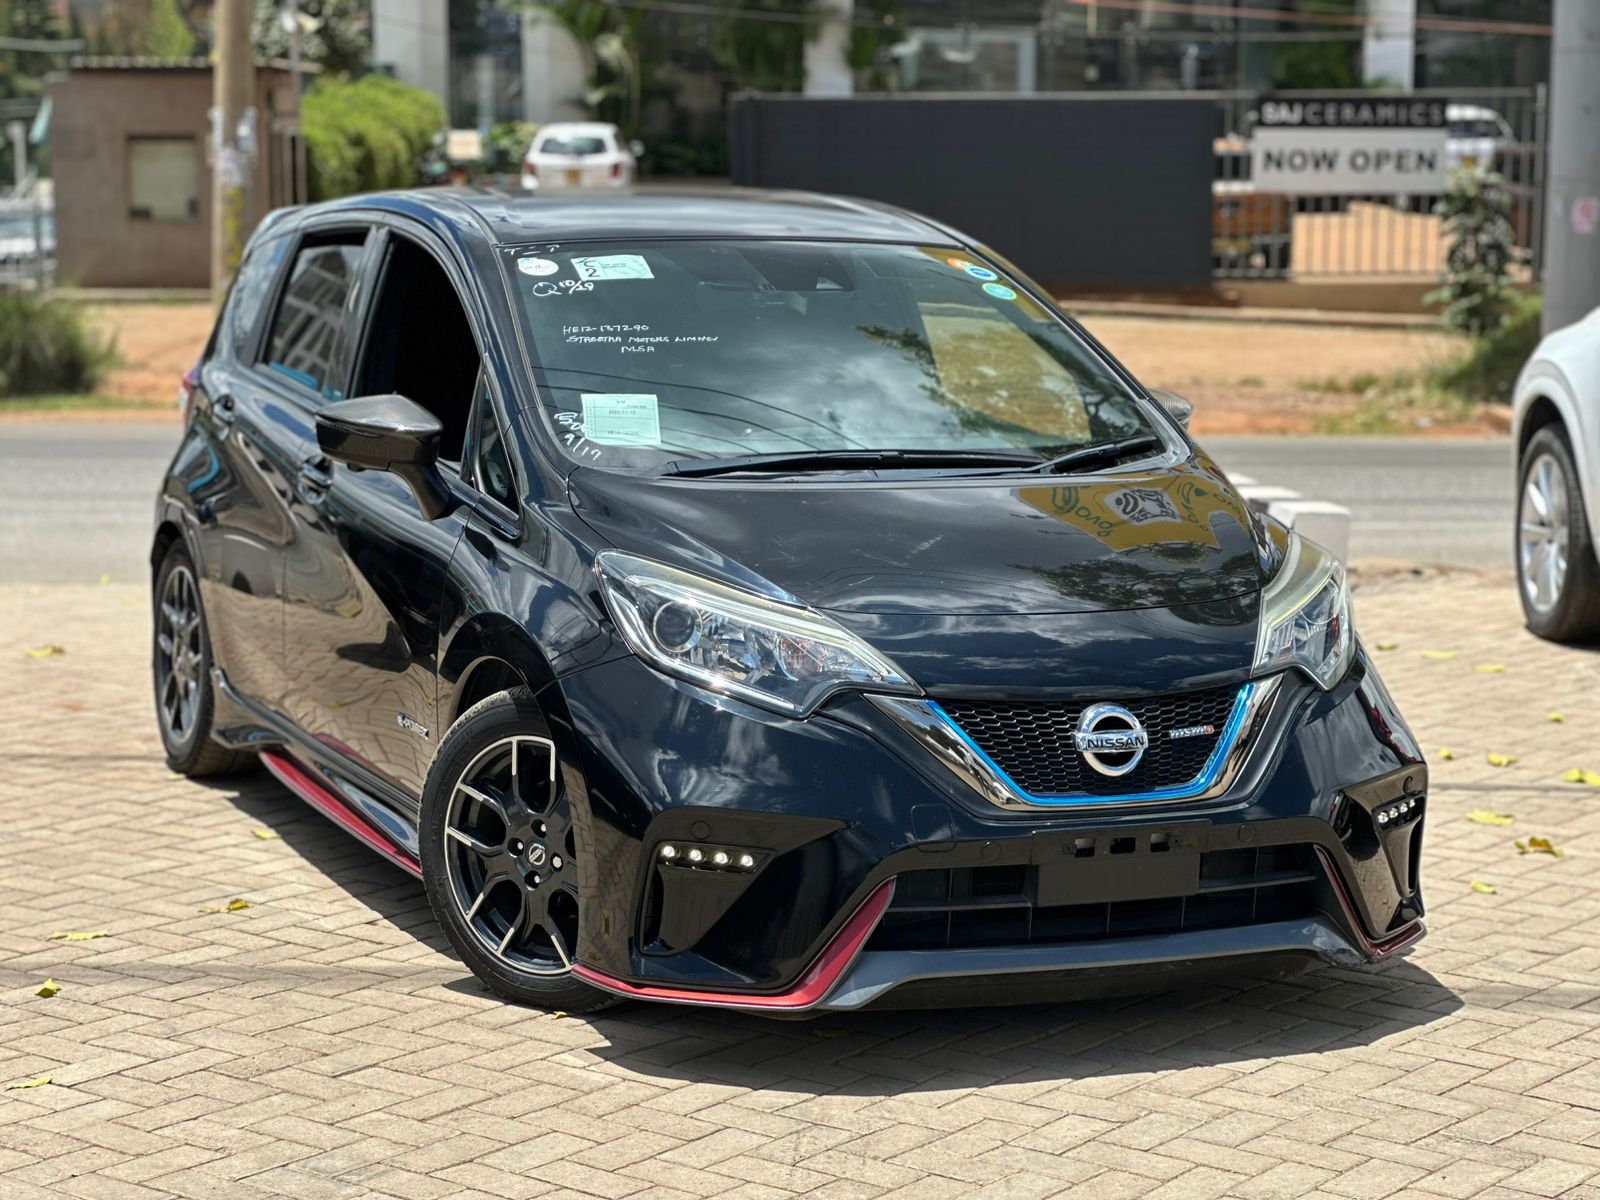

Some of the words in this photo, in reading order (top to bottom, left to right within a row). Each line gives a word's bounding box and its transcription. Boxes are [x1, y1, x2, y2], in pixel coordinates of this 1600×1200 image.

[1263, 149, 1338, 173] NOW
[1350, 149, 1437, 174] OPEN
[532, 281, 562, 296] Q
[628, 336, 670, 344] MOTORS
[1087, 735, 1145, 749] NISSAN
